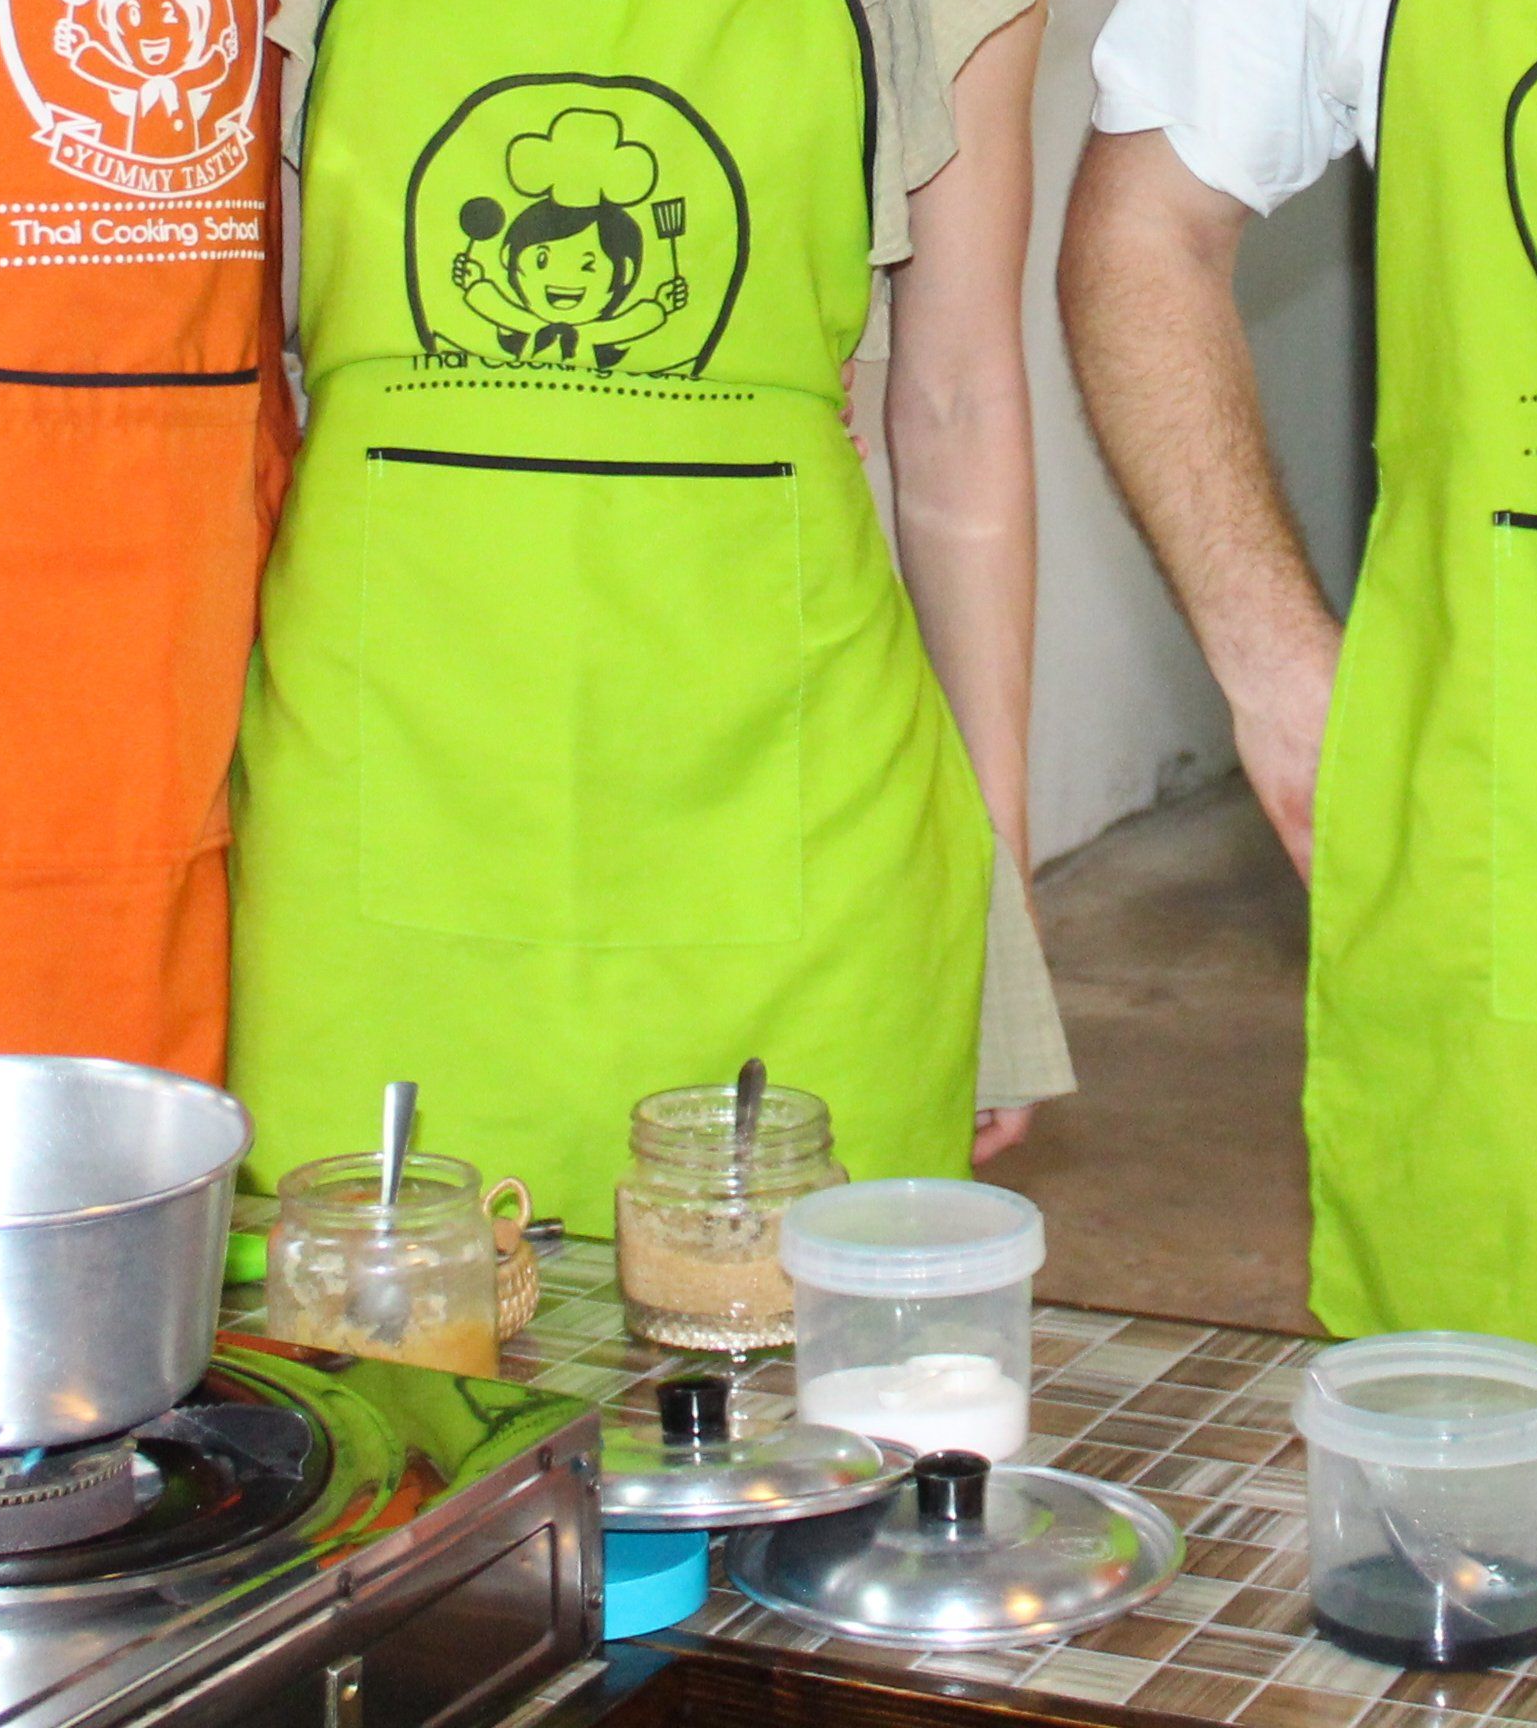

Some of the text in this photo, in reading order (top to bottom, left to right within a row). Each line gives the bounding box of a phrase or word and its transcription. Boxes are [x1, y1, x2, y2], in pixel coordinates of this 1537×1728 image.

[72, 143, 236, 192] YUMMY TASTY
[10, 215, 260, 247] Thai Cooking School
